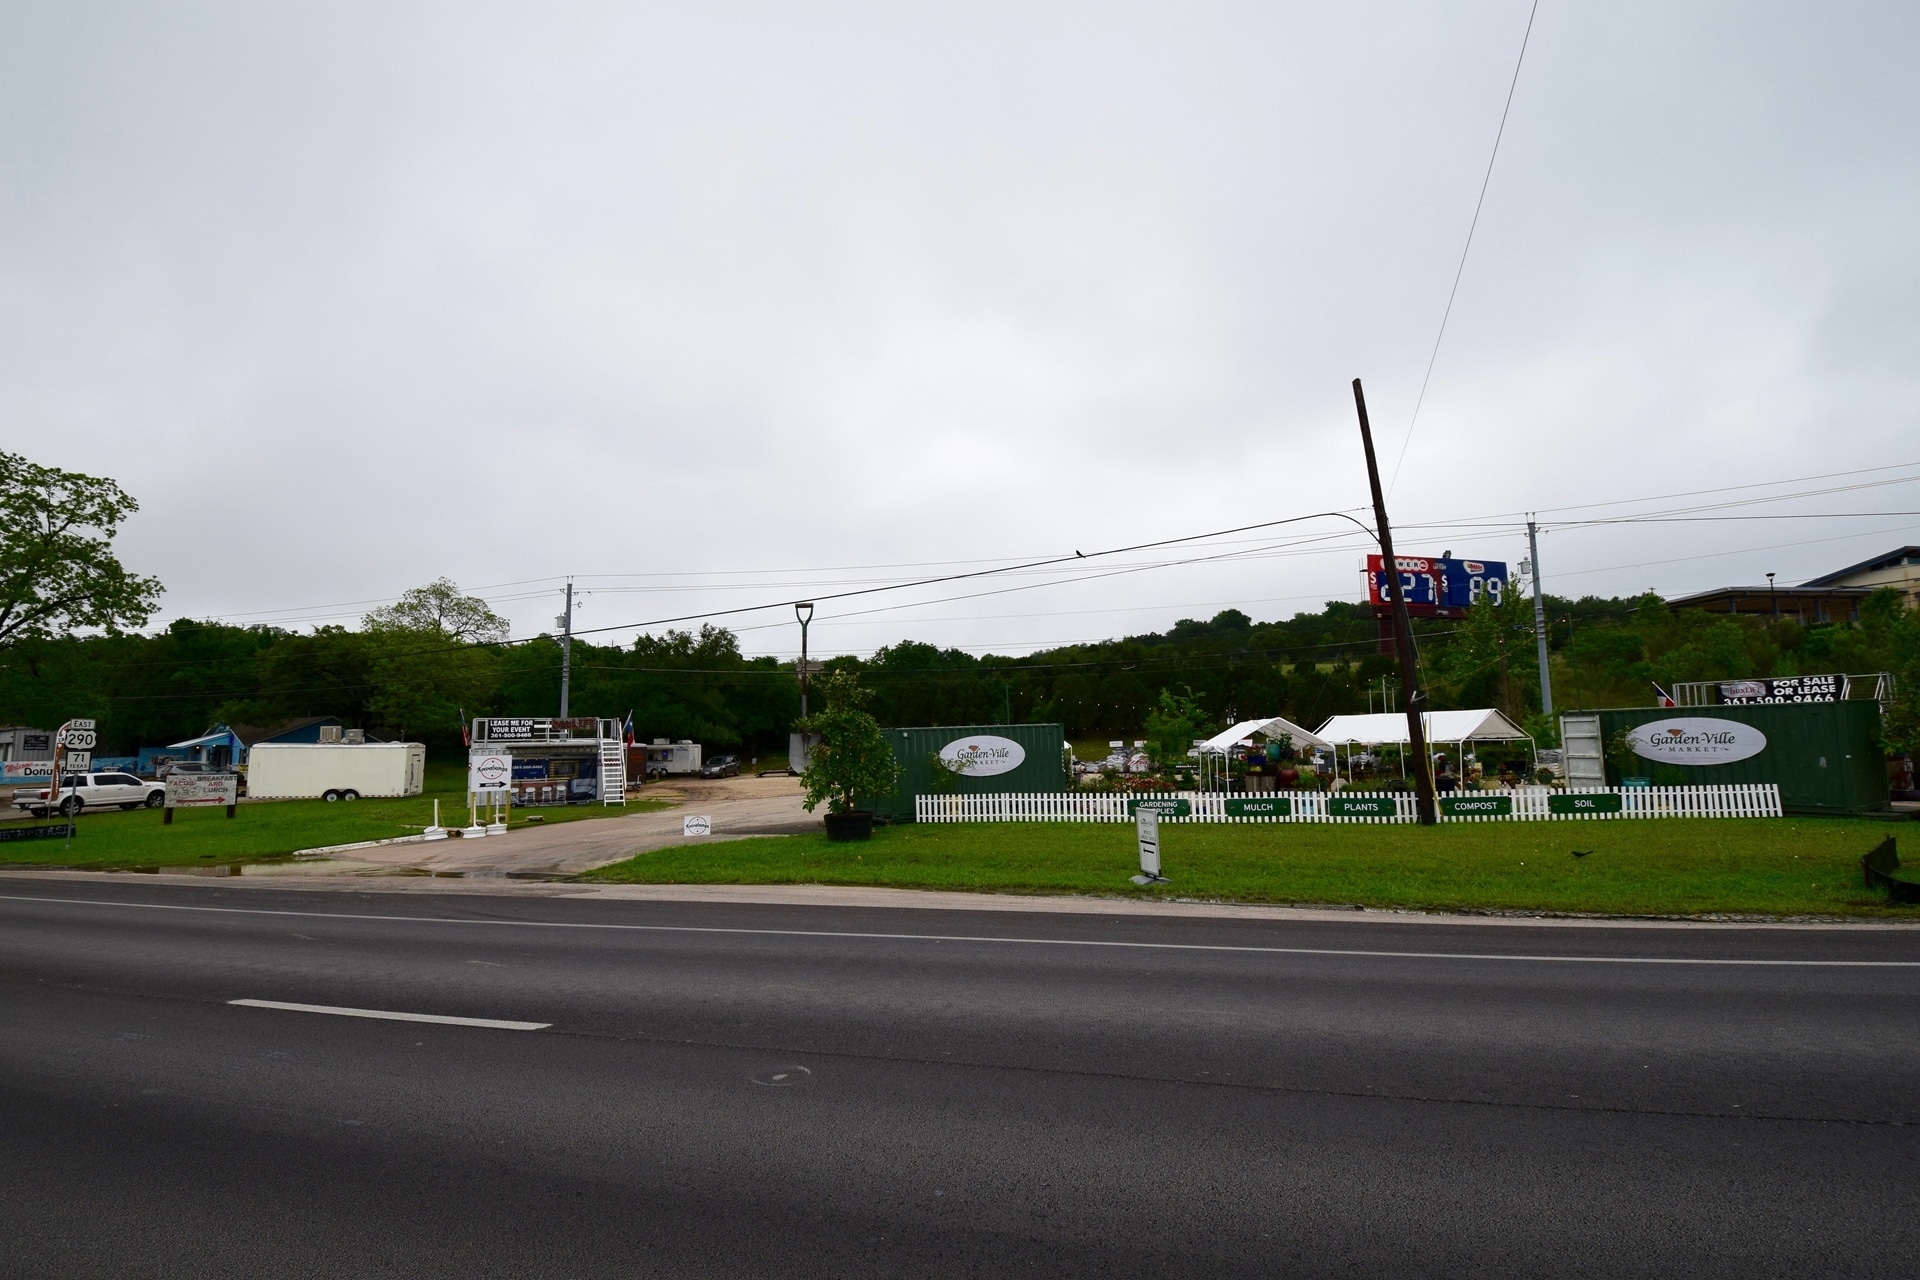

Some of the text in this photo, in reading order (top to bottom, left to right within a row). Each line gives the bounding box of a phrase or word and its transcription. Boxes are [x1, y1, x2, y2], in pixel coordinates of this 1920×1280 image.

[1370, 571, 1377, 585] $
[1441, 574, 1502, 607] $ 89
[1772, 676, 1835, 688] FOR SALE
[1773, 684, 1836, 696] OR LEASE
[1723, 693, 1834, 706] 361-500-9466
[68, 733, 93, 746] 290
[1650, 731, 1736, 747] Garden-Ville
[73, 753, 85, 763] 71
[956, 747, 1010, 760] Garden-Ville
[24, 767, 53, 777] Donu
[1243, 803, 1274, 811] MULCH
[1344, 803, 1379, 811] PLANTS
[1454, 801, 1498, 811] COMPOST
[1574, 799, 1596, 808] SOIL
